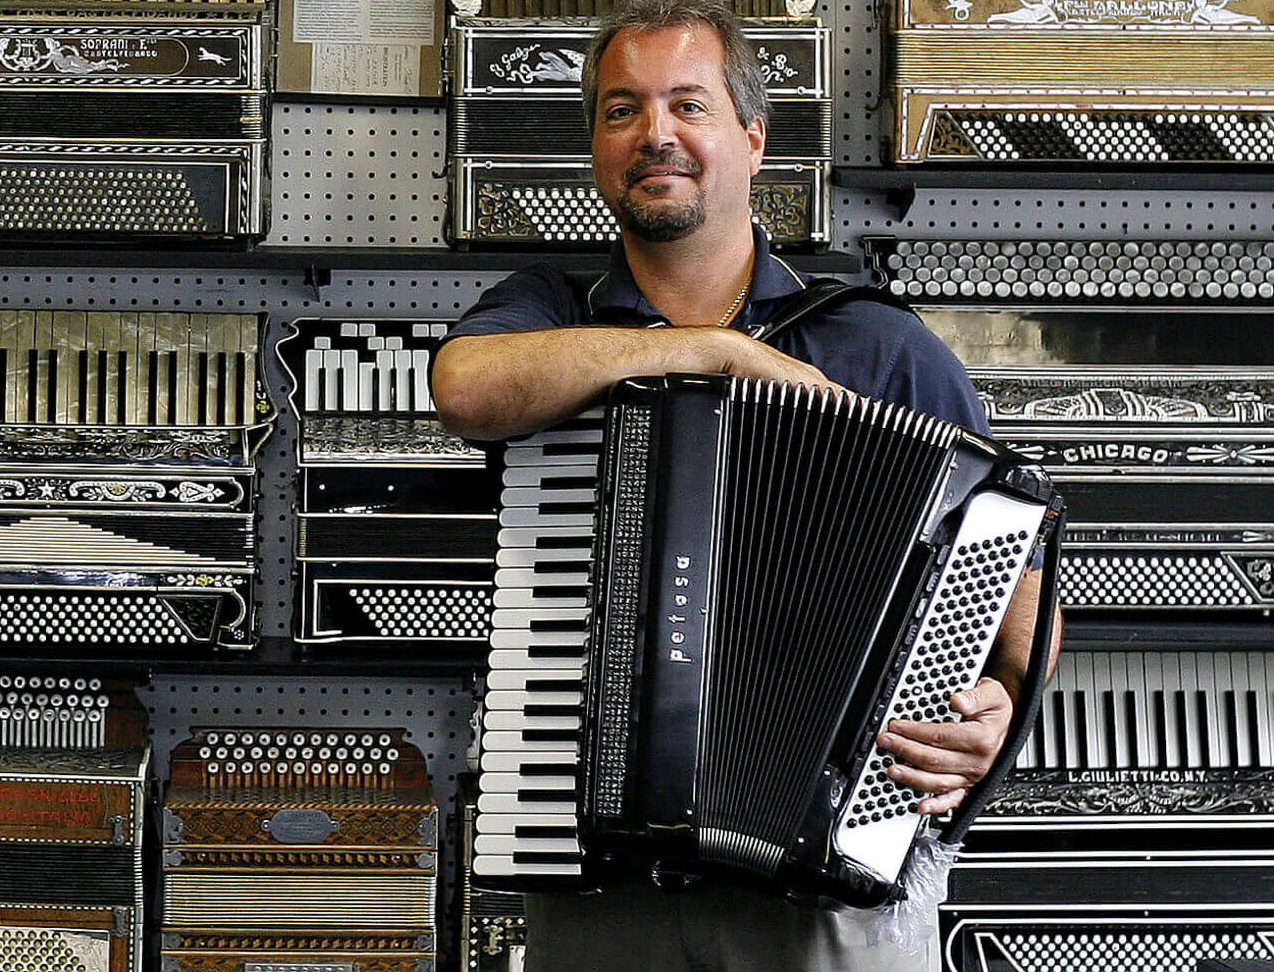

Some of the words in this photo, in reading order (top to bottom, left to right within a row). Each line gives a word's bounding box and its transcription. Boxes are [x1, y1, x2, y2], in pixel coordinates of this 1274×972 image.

[80, 39, 128, 49] SOPRANI
[1062, 443, 1169, 464] CHICAGO
[668, 555, 693, 663] petosa
